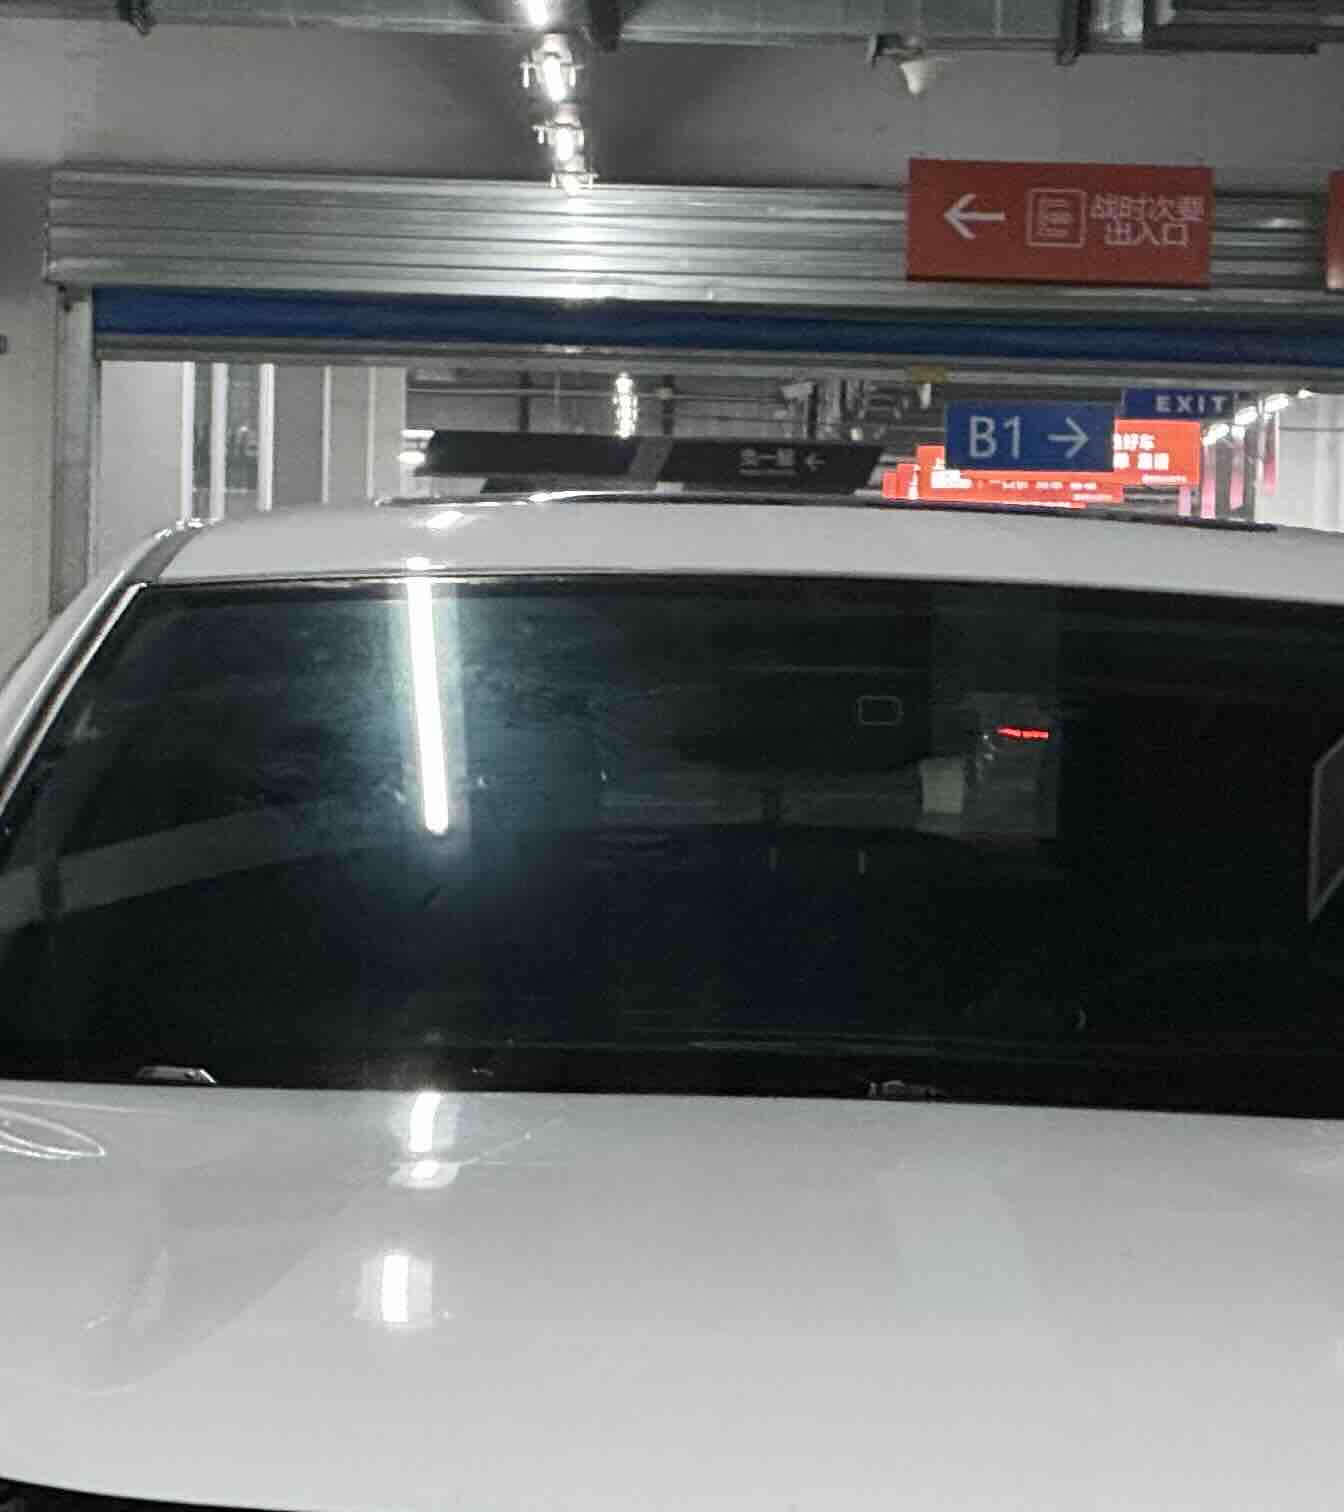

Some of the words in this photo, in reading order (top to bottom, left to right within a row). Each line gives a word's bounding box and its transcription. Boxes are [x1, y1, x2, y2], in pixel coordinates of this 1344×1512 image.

[1105, 219, 1189, 246] 出入口
[1156, 394, 1228, 413] EXIT
[969, 415, 1022, 460] B1
